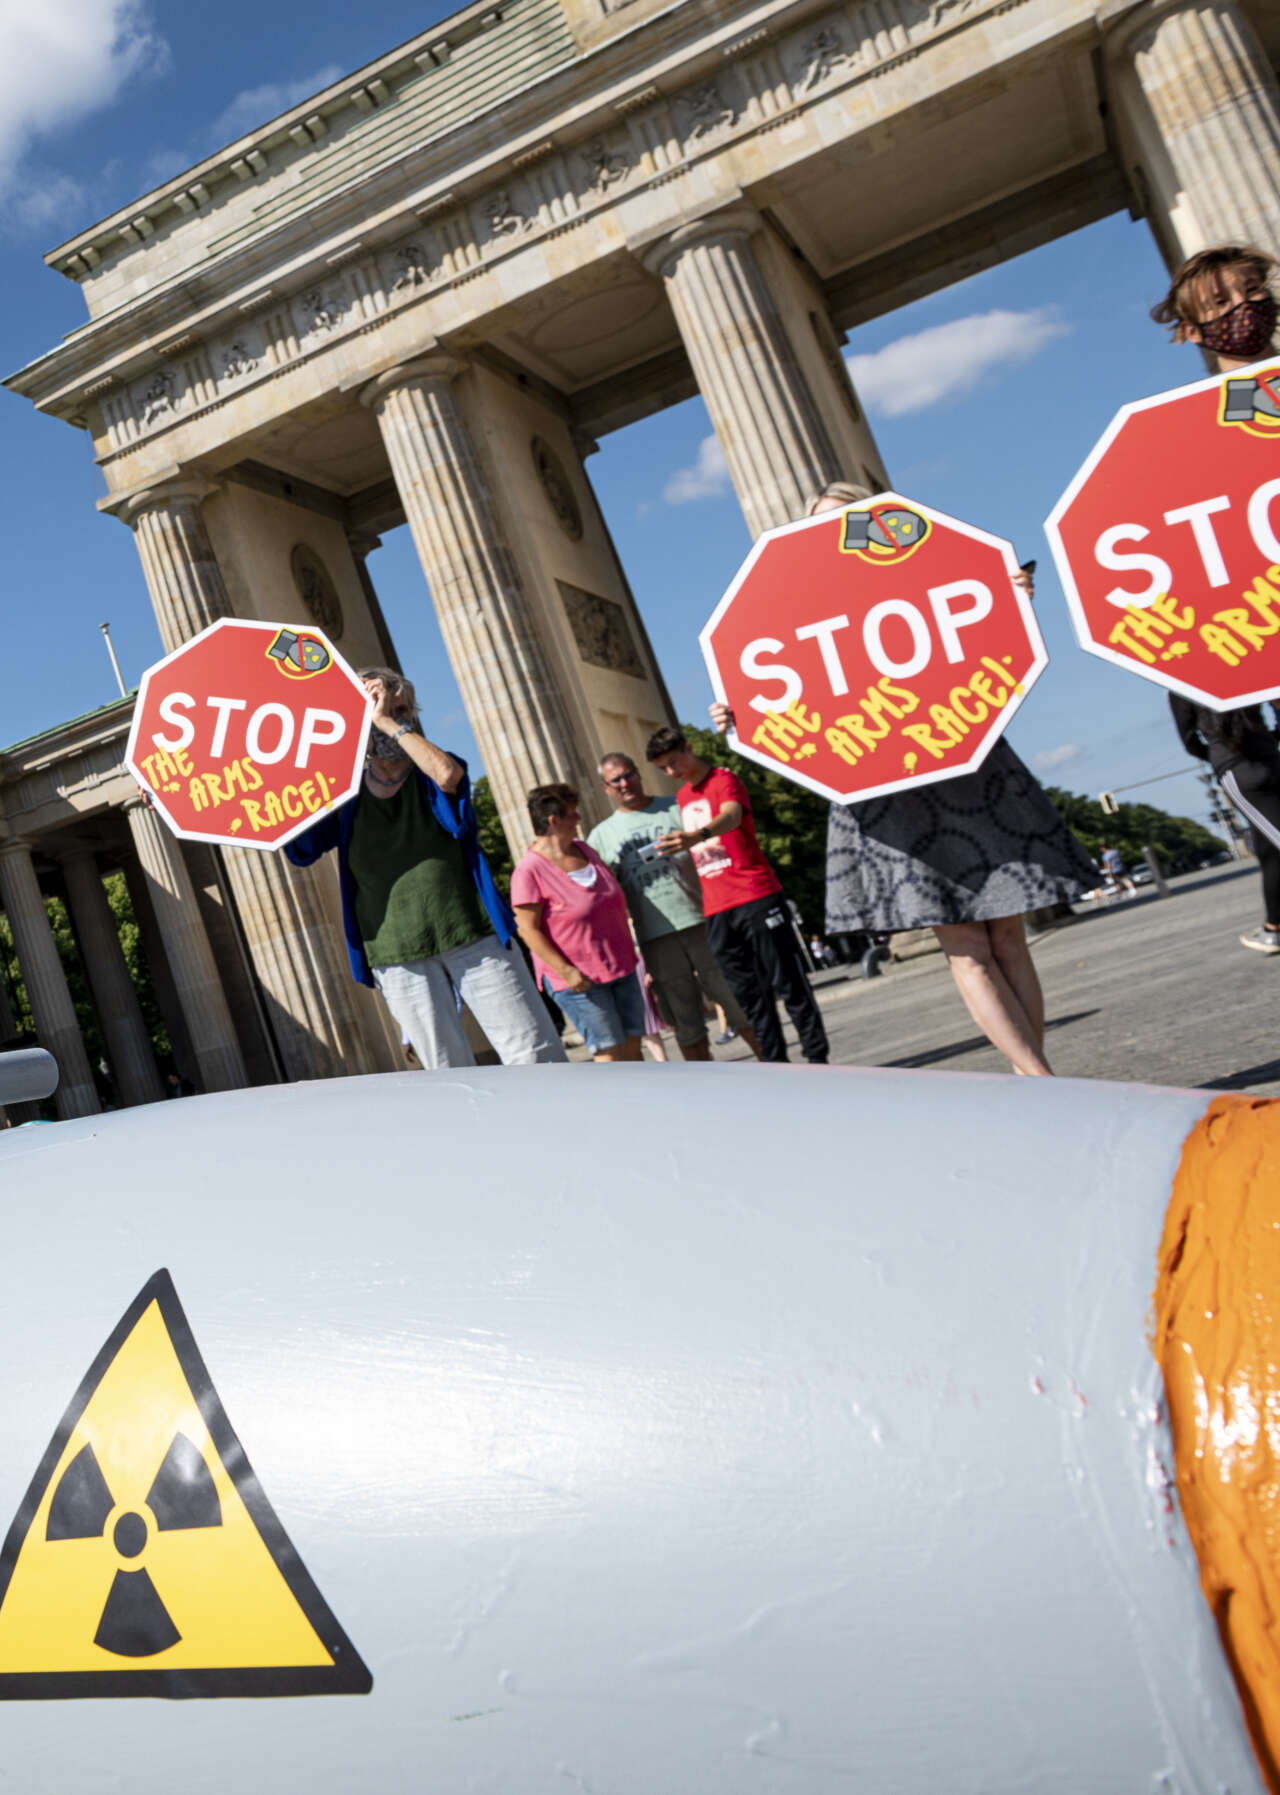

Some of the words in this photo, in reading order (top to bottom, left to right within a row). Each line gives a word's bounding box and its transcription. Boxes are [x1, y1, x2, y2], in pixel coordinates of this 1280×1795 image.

[740, 579, 993, 714] STOP
[1109, 592, 1195, 663] THE
[1199, 564, 1280, 667] ARM
[151, 692, 346, 769] STOP
[752, 699, 821, 762] THE
[825, 676, 920, 765] ARMS
[902, 655, 1024, 759] RACE!
[141, 746, 194, 790] THE
[189, 756, 263, 812] ARMS
[240, 771, 334, 832] RACE!
